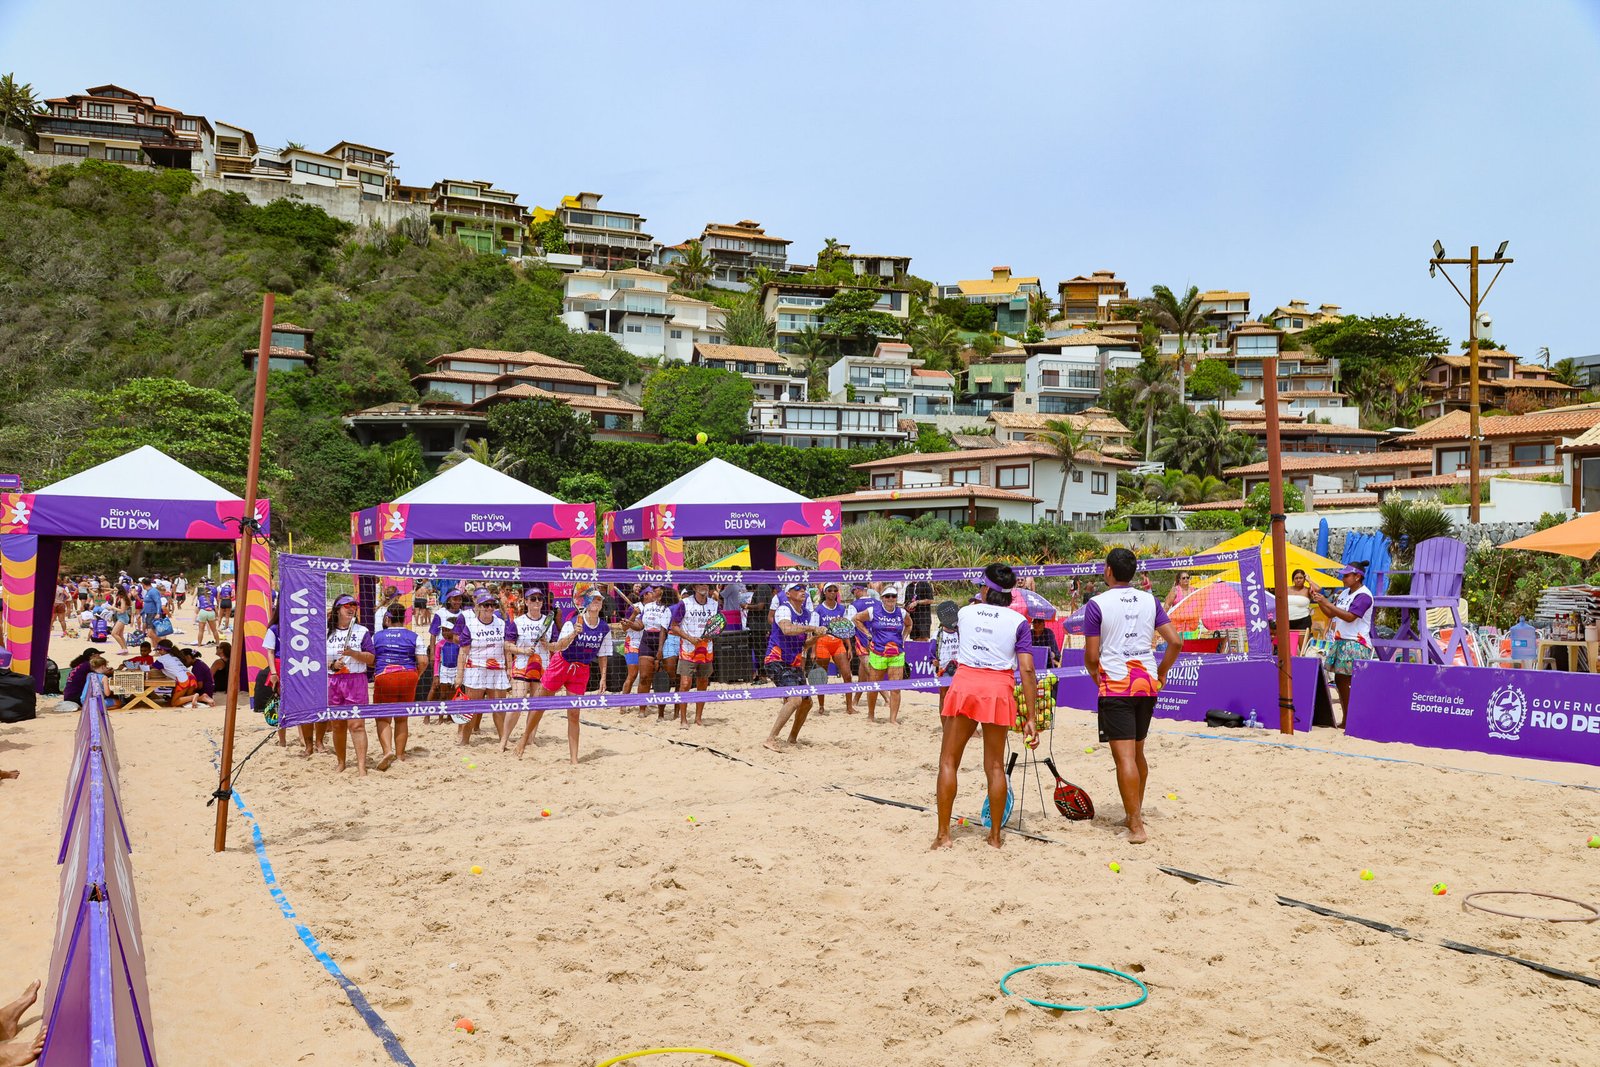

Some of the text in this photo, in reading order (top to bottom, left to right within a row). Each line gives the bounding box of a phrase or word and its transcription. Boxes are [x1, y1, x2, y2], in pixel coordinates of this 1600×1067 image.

[109, 508, 151, 518] Rio+Vivo
[471, 513, 505, 521] Rio+Vivo
[100, 517, 159, 530] DEU BOM
[464, 520, 511, 532] DEU BOM
[724, 518, 766, 529] DEU BOM
[307, 557, 339, 571] vivo
[1171, 558, 1187, 567] vivo
[397, 564, 426, 575] vivo
[481, 567, 510, 578] vivo
[561, 569, 588, 580] vivo
[963, 569, 983, 578] vivo
[1019, 567, 1037, 576] vivo
[1072, 565, 1090, 574] vivo
[637, 571, 663, 581] vivo
[709, 572, 733, 582] vivo
[777, 572, 800, 582] vivo
[842, 571, 864, 581] vivo
[904, 570, 925, 580] vivo
[1246, 571, 1261, 615] vivo
[290, 588, 318, 652] vivo
[578, 632, 597, 641] vivo
[1225, 653, 1242, 661] vivo
[1180, 658, 1197, 667] vivo
[850, 684, 872, 692] vivo
[1165, 679, 1198, 687] PREFEITURA
[717, 691, 742, 700] vivo
[785, 688, 808, 696] vivo
[570, 697, 597, 707] vivo
[646, 695, 671, 704] vivo
[1411, 692, 1465, 705] Secretaria de
[406, 704, 436, 715] vivo
[490, 700, 519, 711] vivo
[1410, 702, 1474, 716] Esporte e Lazer
[317, 708, 348, 719] vivo
[1530, 710, 1600, 734] RIO DE
